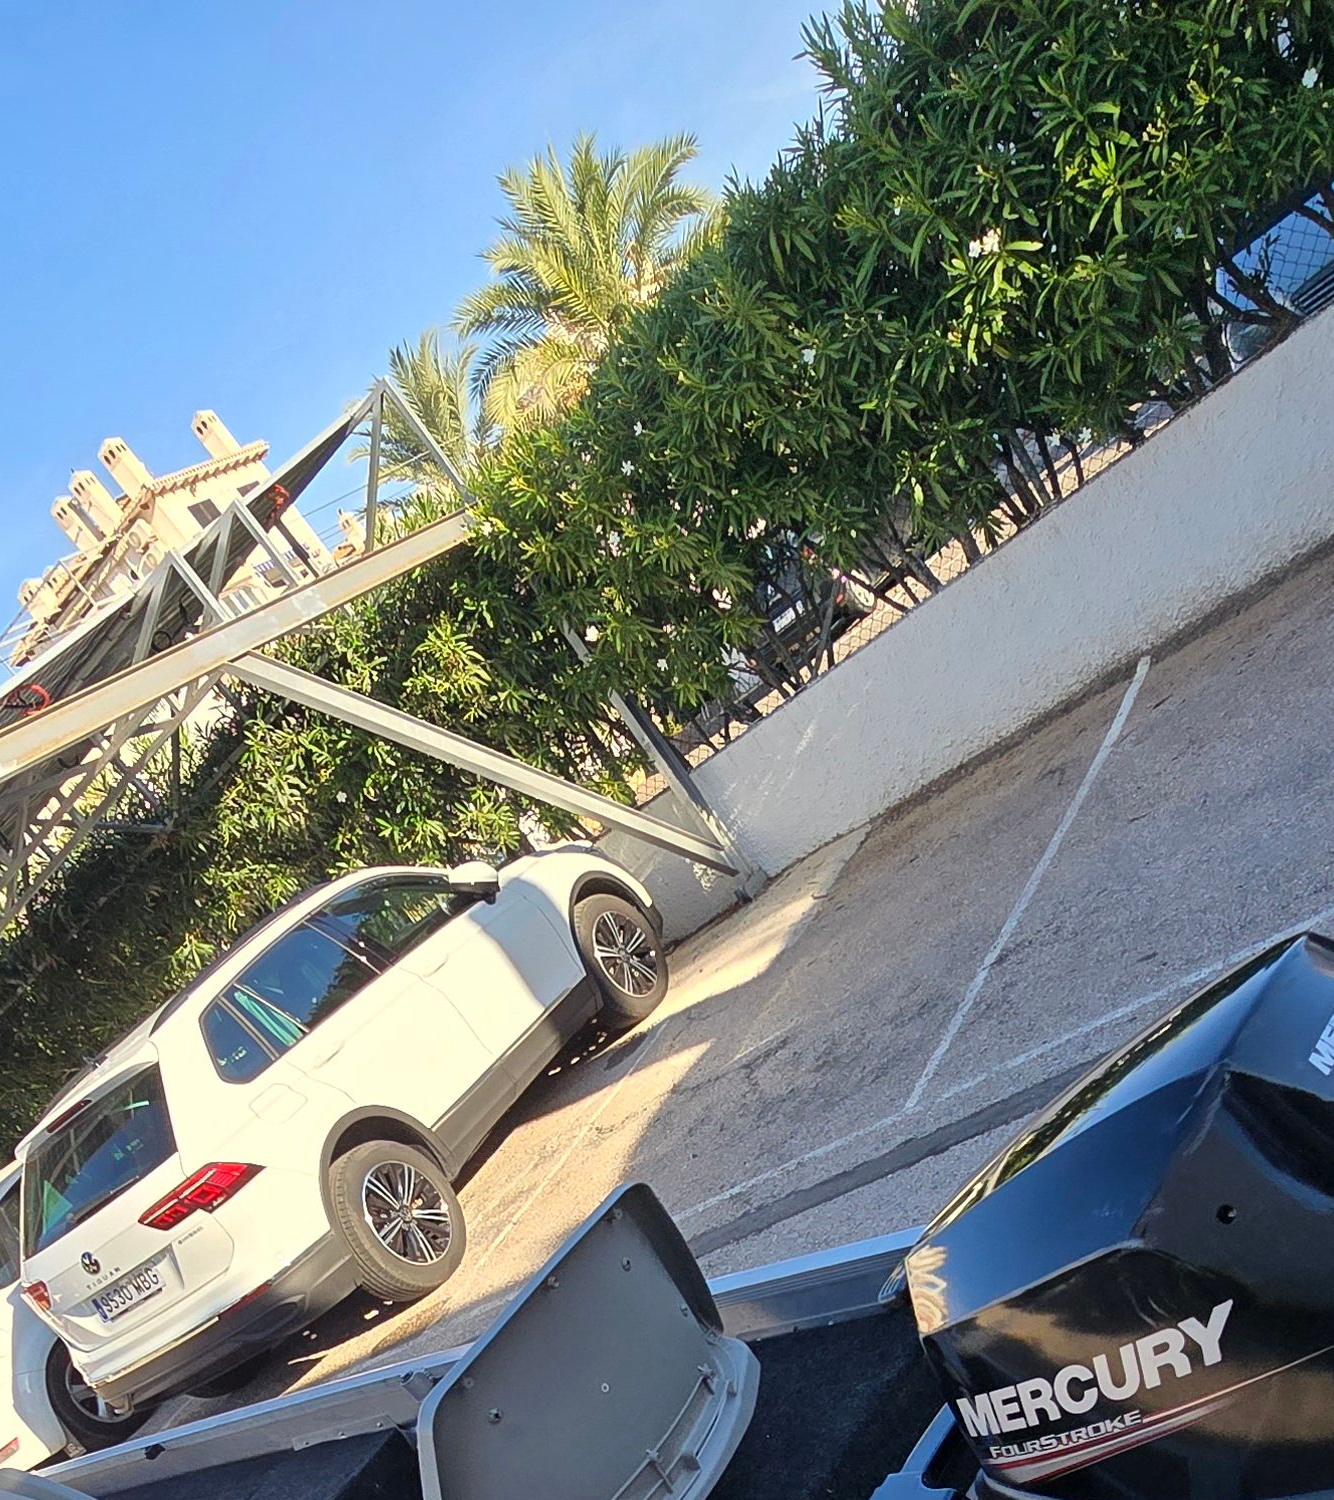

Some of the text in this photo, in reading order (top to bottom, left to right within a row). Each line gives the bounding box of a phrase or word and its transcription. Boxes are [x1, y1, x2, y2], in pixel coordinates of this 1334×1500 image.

[86, 1266, 122, 1290] TIGUAN
[100, 1285, 134, 1313] 9530
[131, 1267, 159, 1296] MBG
[956, 1299, 1234, 1438] MERCURY
